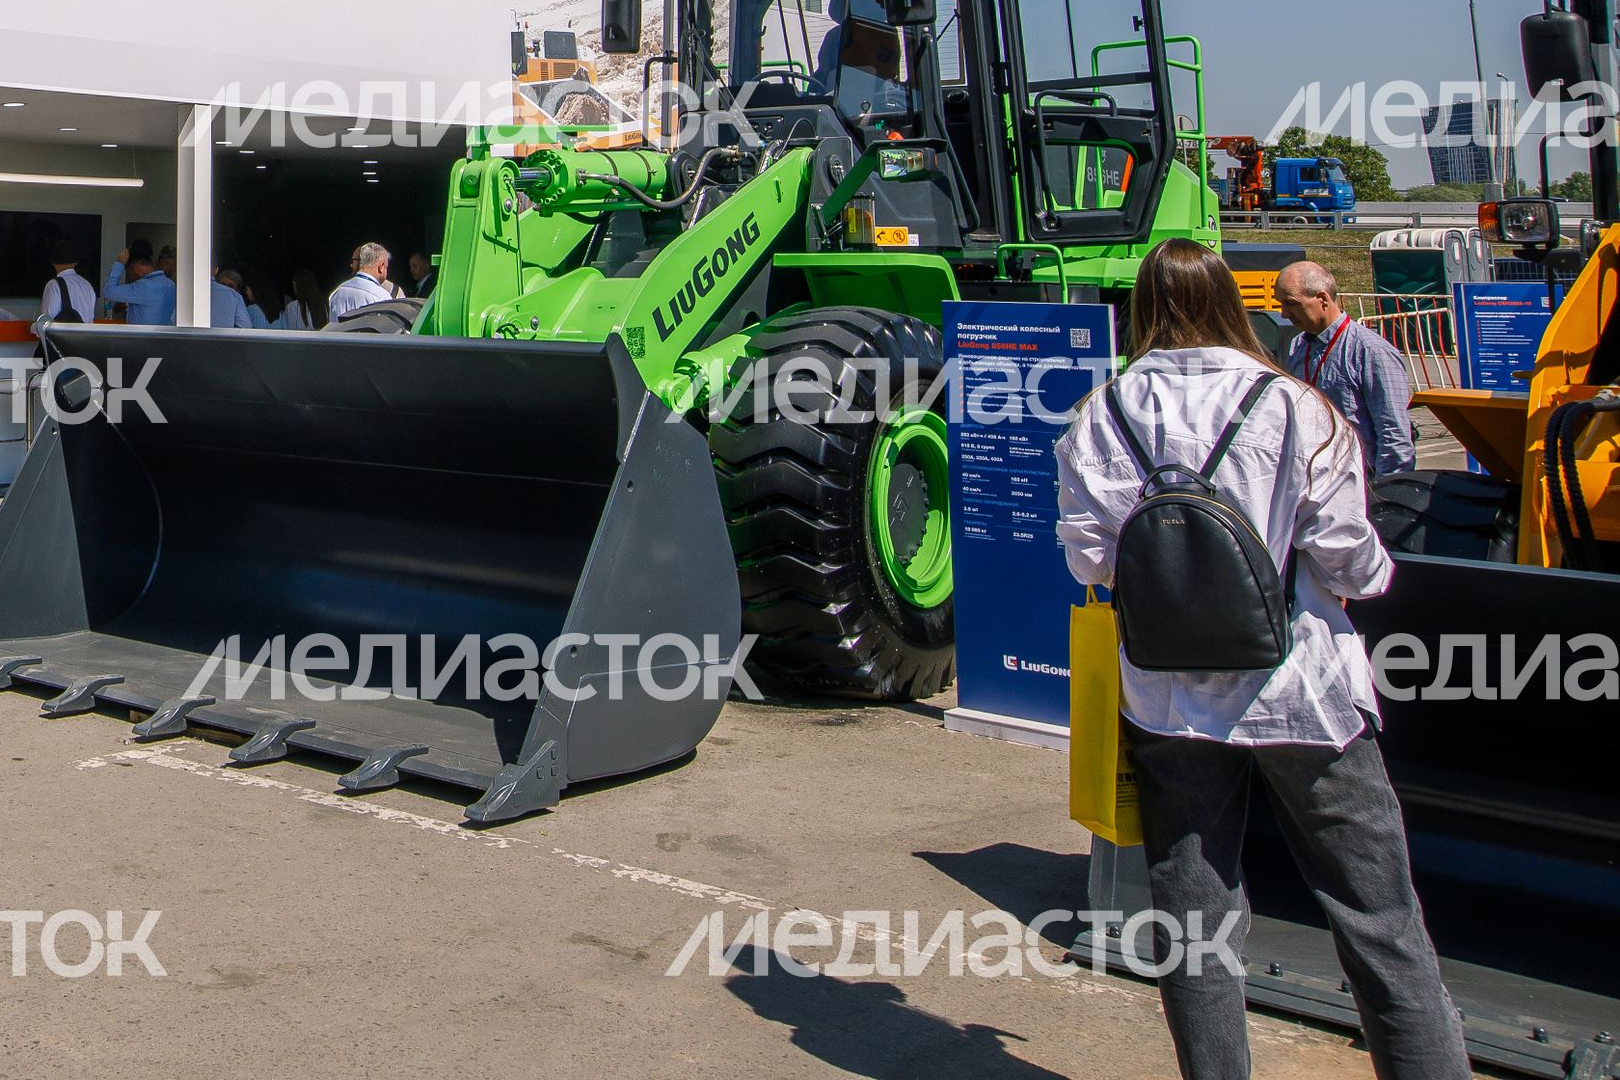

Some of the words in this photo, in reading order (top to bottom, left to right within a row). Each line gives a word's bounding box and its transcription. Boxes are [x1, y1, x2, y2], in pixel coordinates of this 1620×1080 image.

[651, 211, 760, 342] LIUGONG
[957, 323, 1018, 332] Электрический
[957, 333, 997, 341] погрузчик
